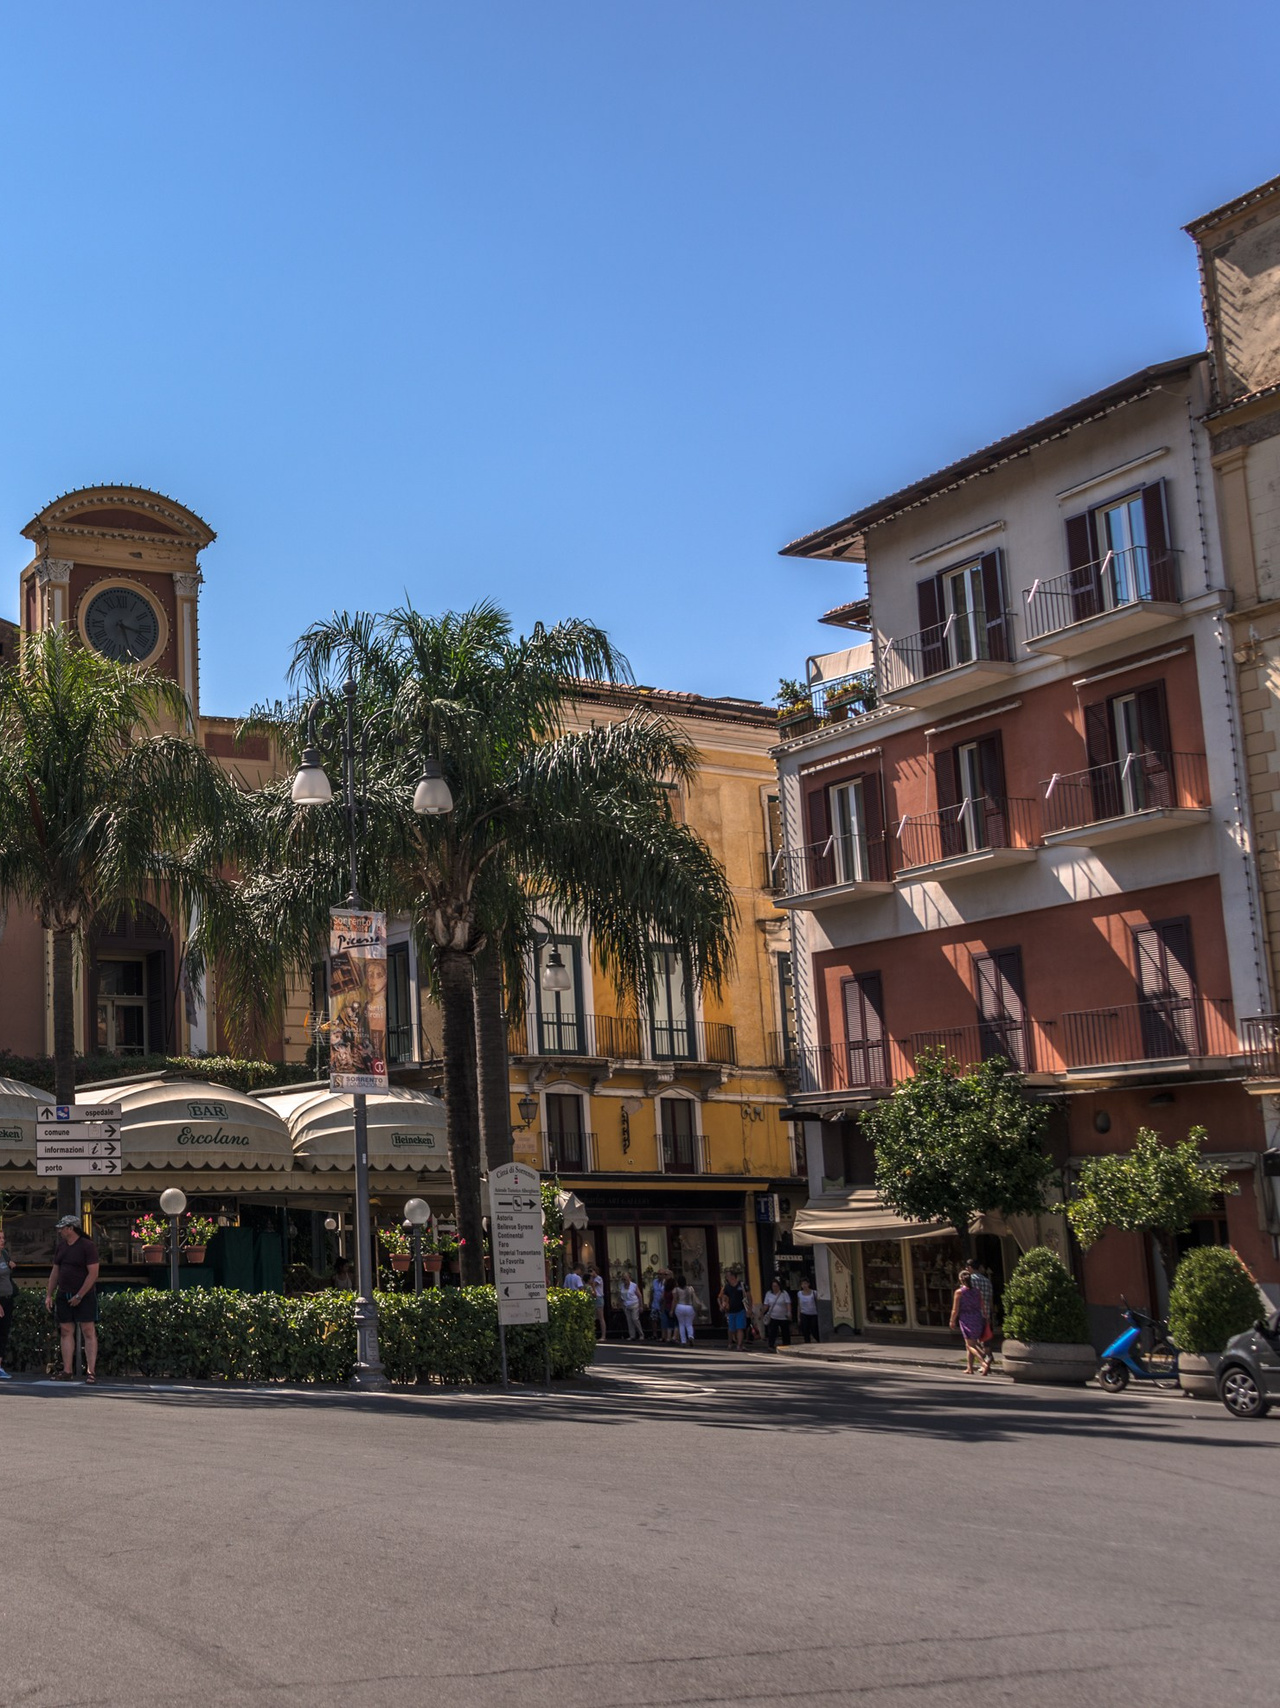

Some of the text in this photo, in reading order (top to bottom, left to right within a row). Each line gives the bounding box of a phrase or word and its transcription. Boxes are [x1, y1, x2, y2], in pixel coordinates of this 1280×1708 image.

[85, 1108, 114, 1117] ospedale
[192, 1105, 225, 1117] BAR
[177, 1126, 250, 1146] Ercolano
[394, 1135, 433, 1145] Heineken
[515, 1166, 535, 1180] Sorrento
